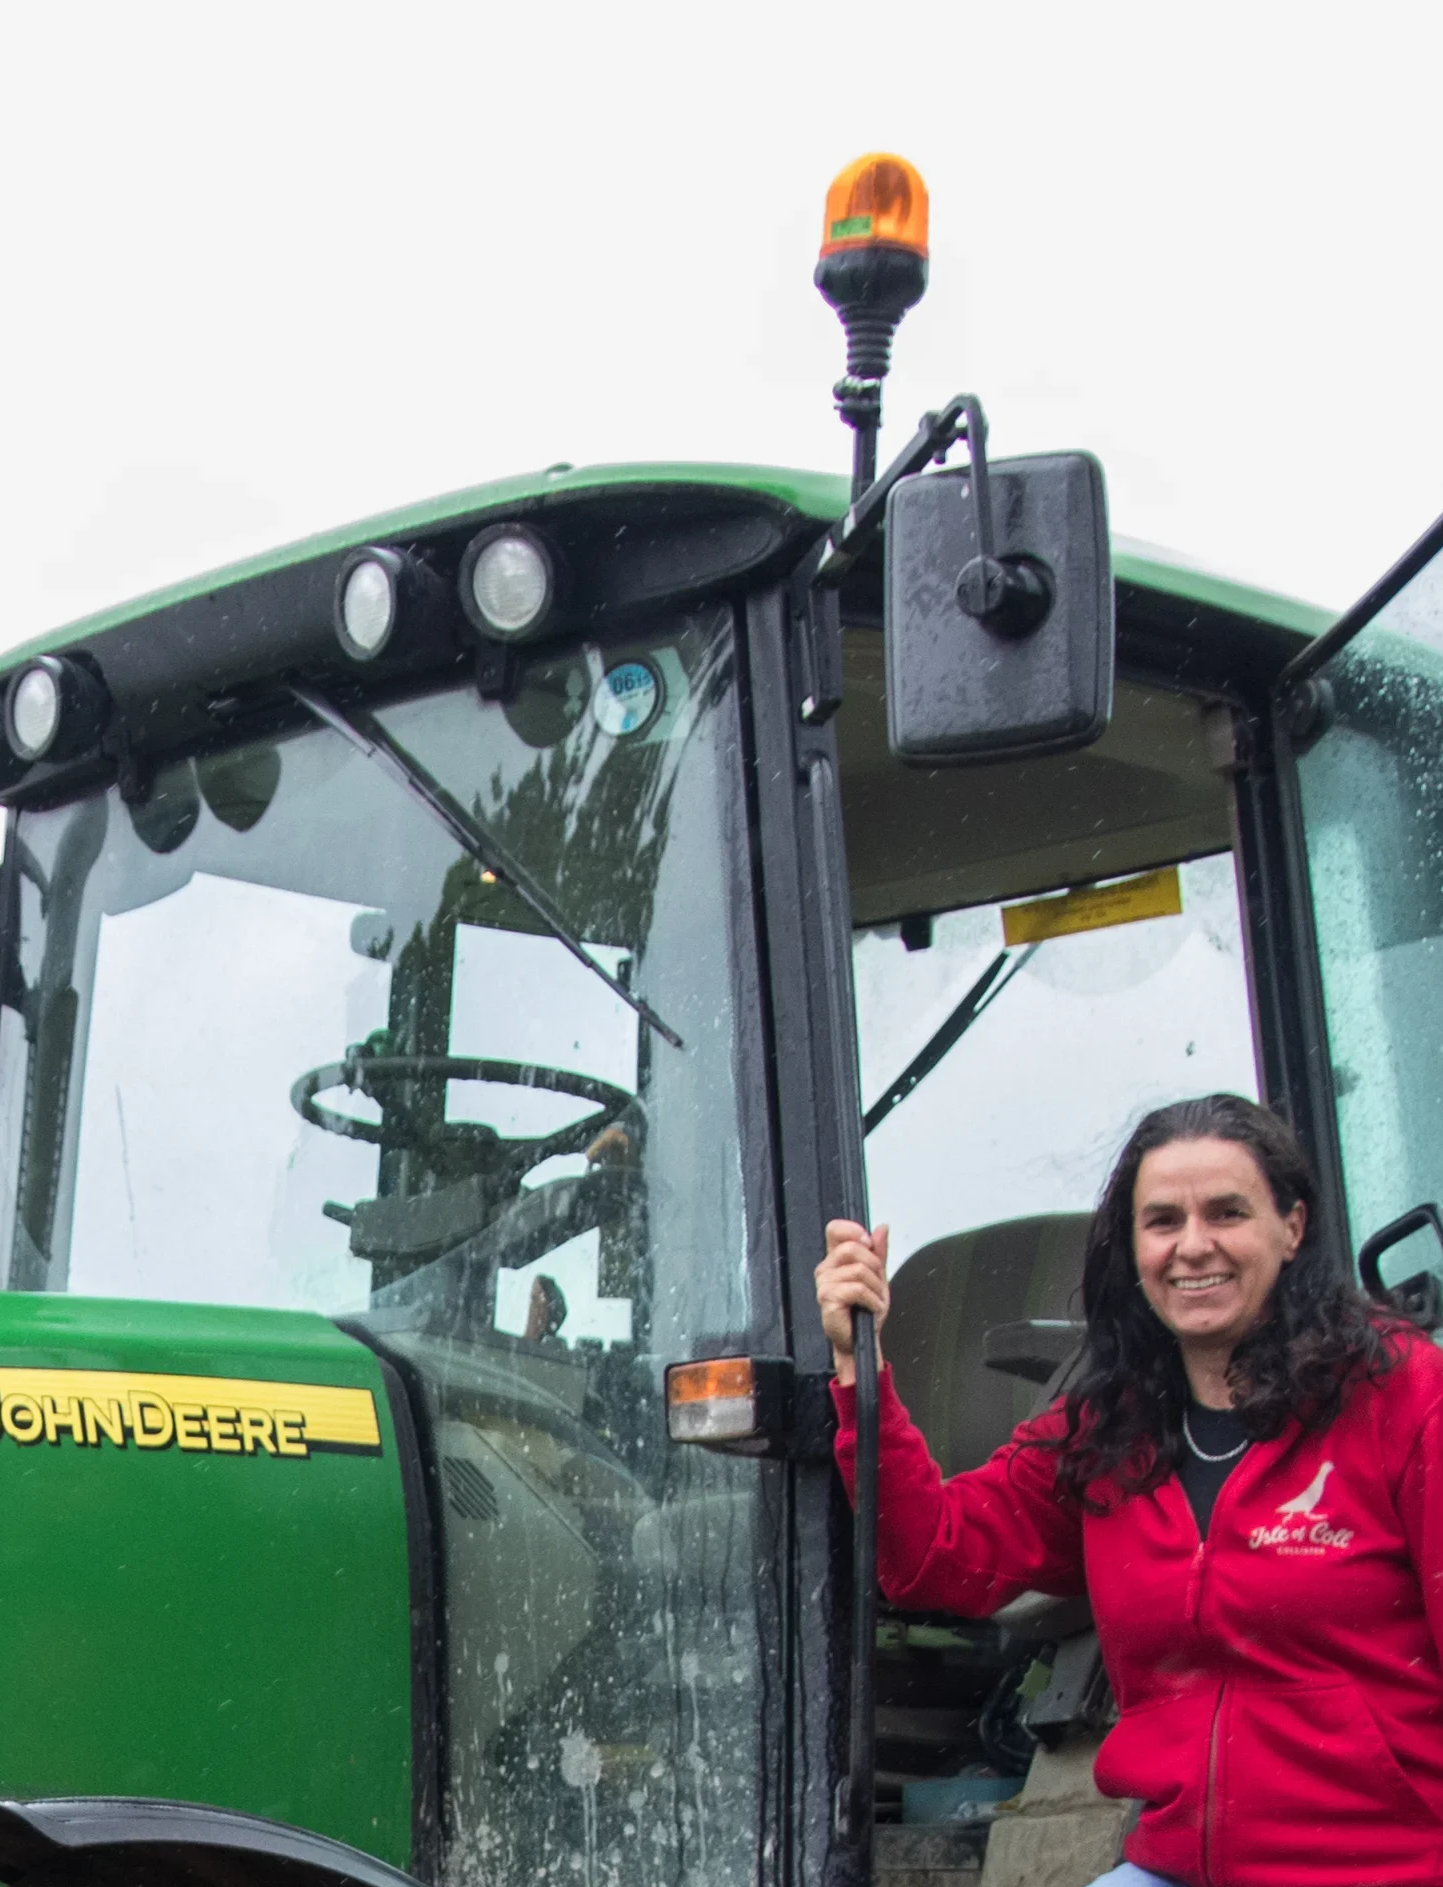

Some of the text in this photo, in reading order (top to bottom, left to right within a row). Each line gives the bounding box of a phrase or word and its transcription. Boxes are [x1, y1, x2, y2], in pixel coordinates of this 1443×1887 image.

[127, 1388, 311, 1459] DEERE
[1249, 1522, 1354, 1549] Isle of Coll
